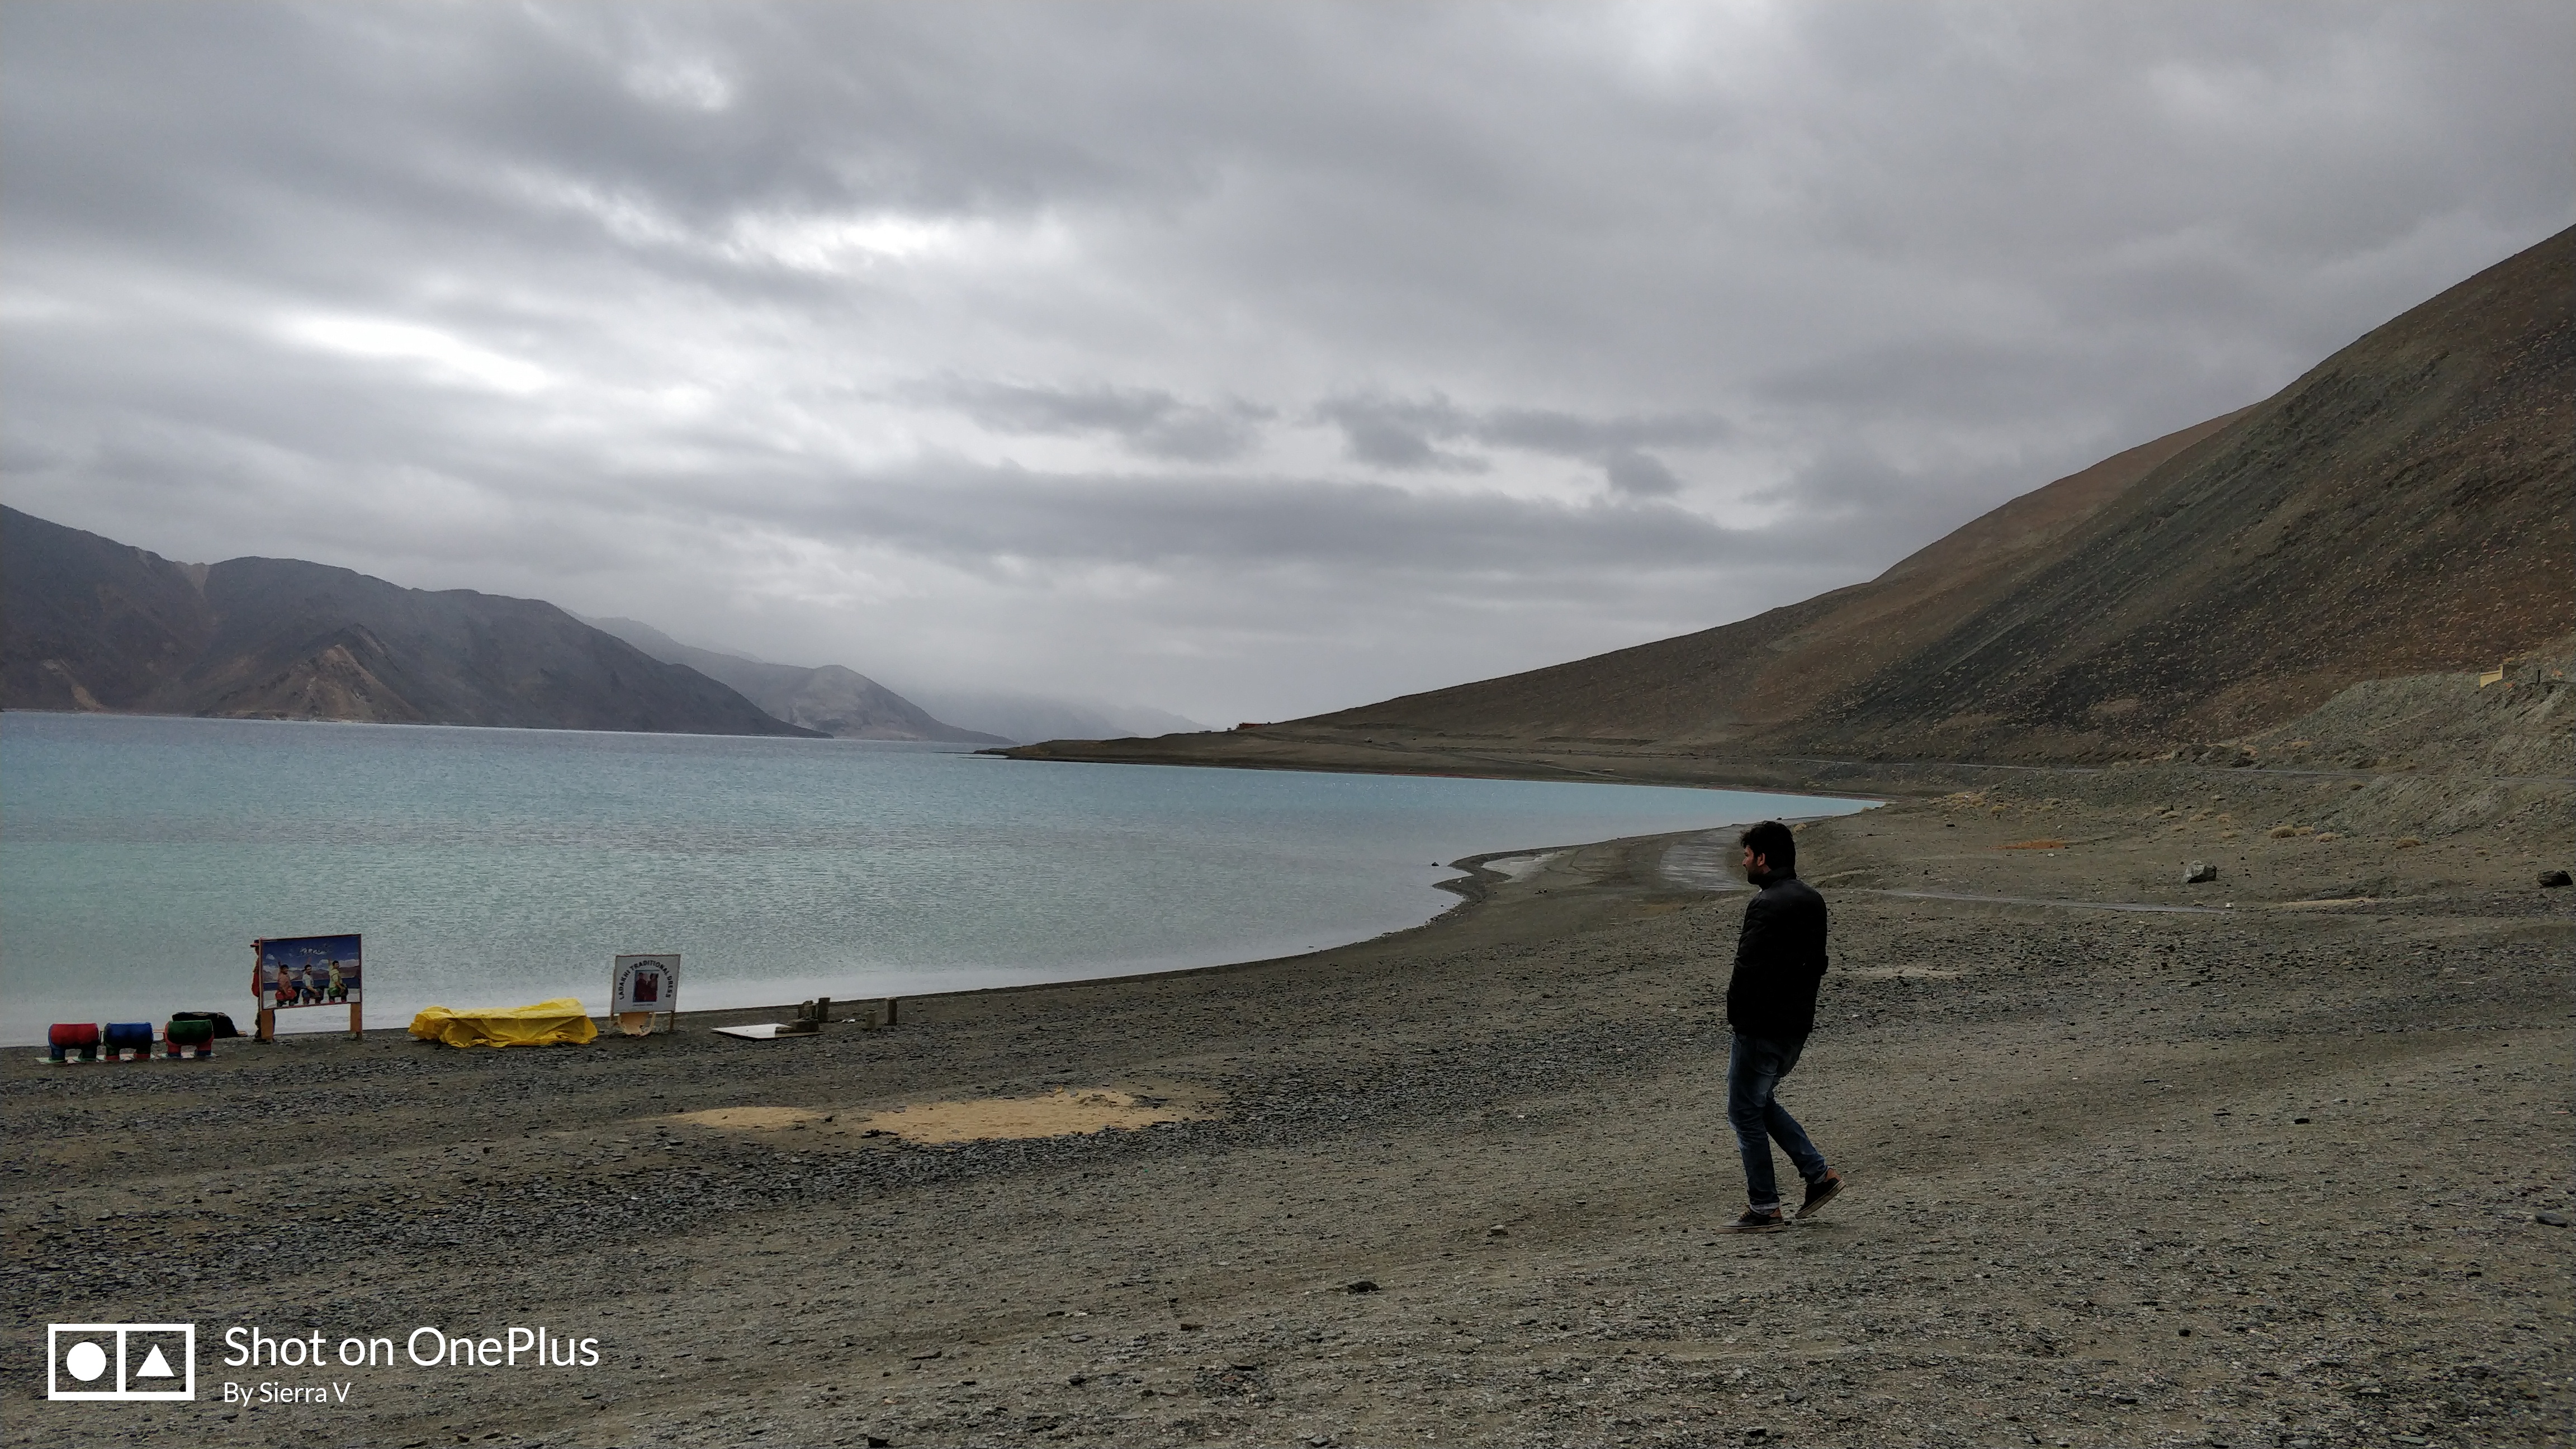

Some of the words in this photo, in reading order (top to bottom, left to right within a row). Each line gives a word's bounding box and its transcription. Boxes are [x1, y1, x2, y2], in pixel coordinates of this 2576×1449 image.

[618, 970, 631, 1000] LADAKHI
[629, 960, 670, 976] TRADITIONAL
[665, 976, 674, 998] DRESS
